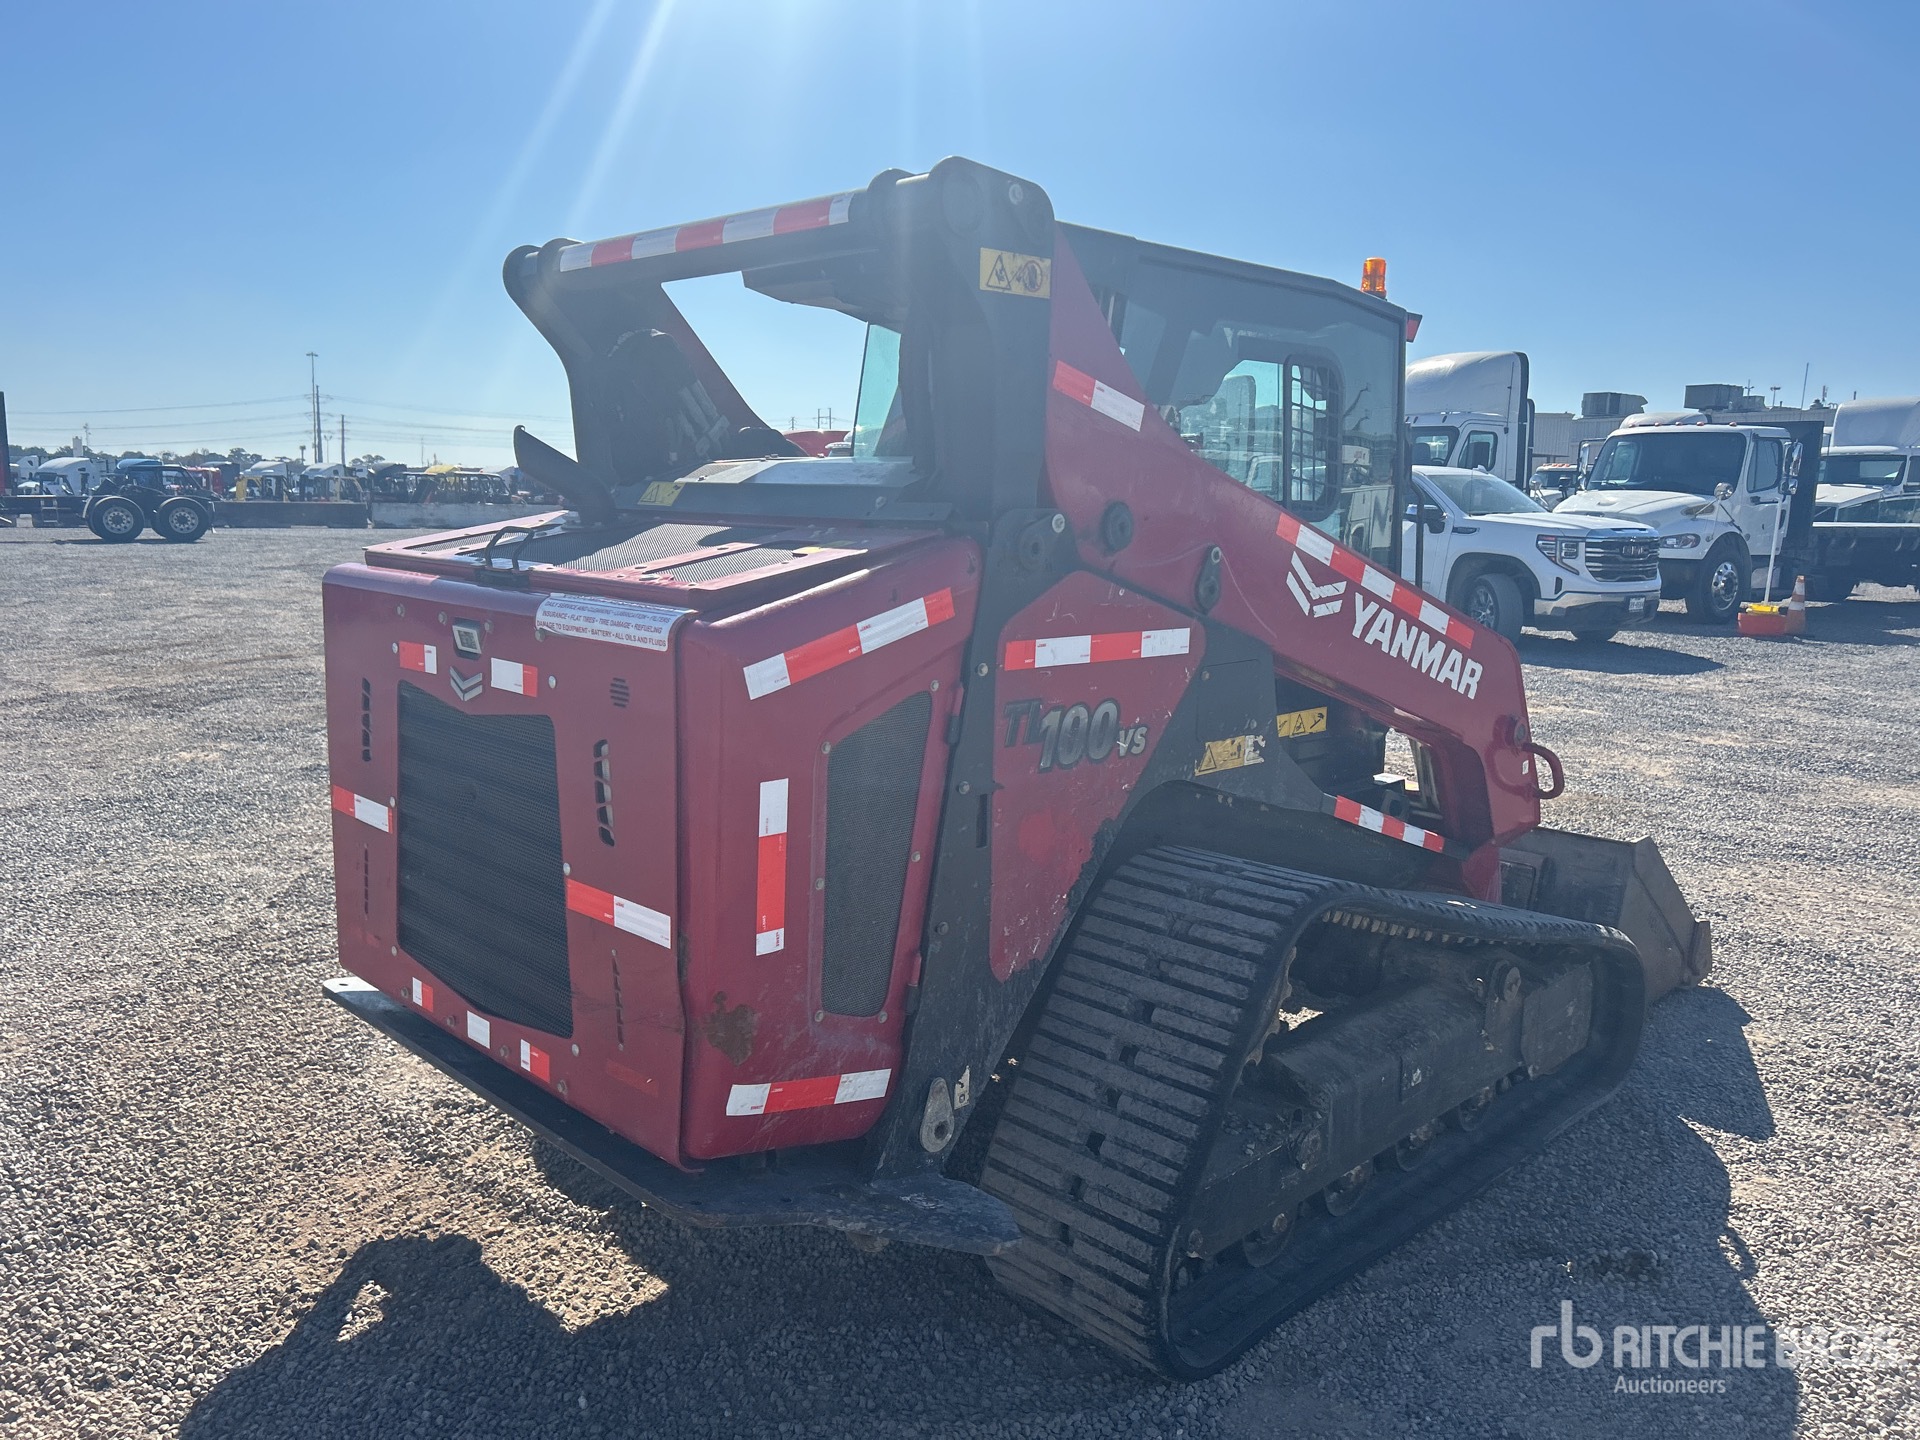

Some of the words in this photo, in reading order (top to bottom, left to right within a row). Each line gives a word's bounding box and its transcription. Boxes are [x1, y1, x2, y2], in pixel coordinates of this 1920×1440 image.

[542, 610, 568, 620] INSURANCE
[583, 616, 596, 624] TIRES
[599, 618, 609, 626] TIRE
[610, 620, 631, 629] DAMAGE
[634, 623, 662, 634] REFUELING
[557, 602, 577, 610] SERVICE
[650, 615, 671, 624] FILTERS
[537, 620, 555, 629] DAMAGE
[563, 624, 588, 634] EQUIPMENT
[591, 628, 612, 637] BATTERY
[615, 632, 624, 640] ALL
[625, 633, 636, 641] OILS
[637, 635, 648, 644] AND
[649, 638, 666, 647] FLUIDS
[1352, 592, 1483, 700] YANMAR
